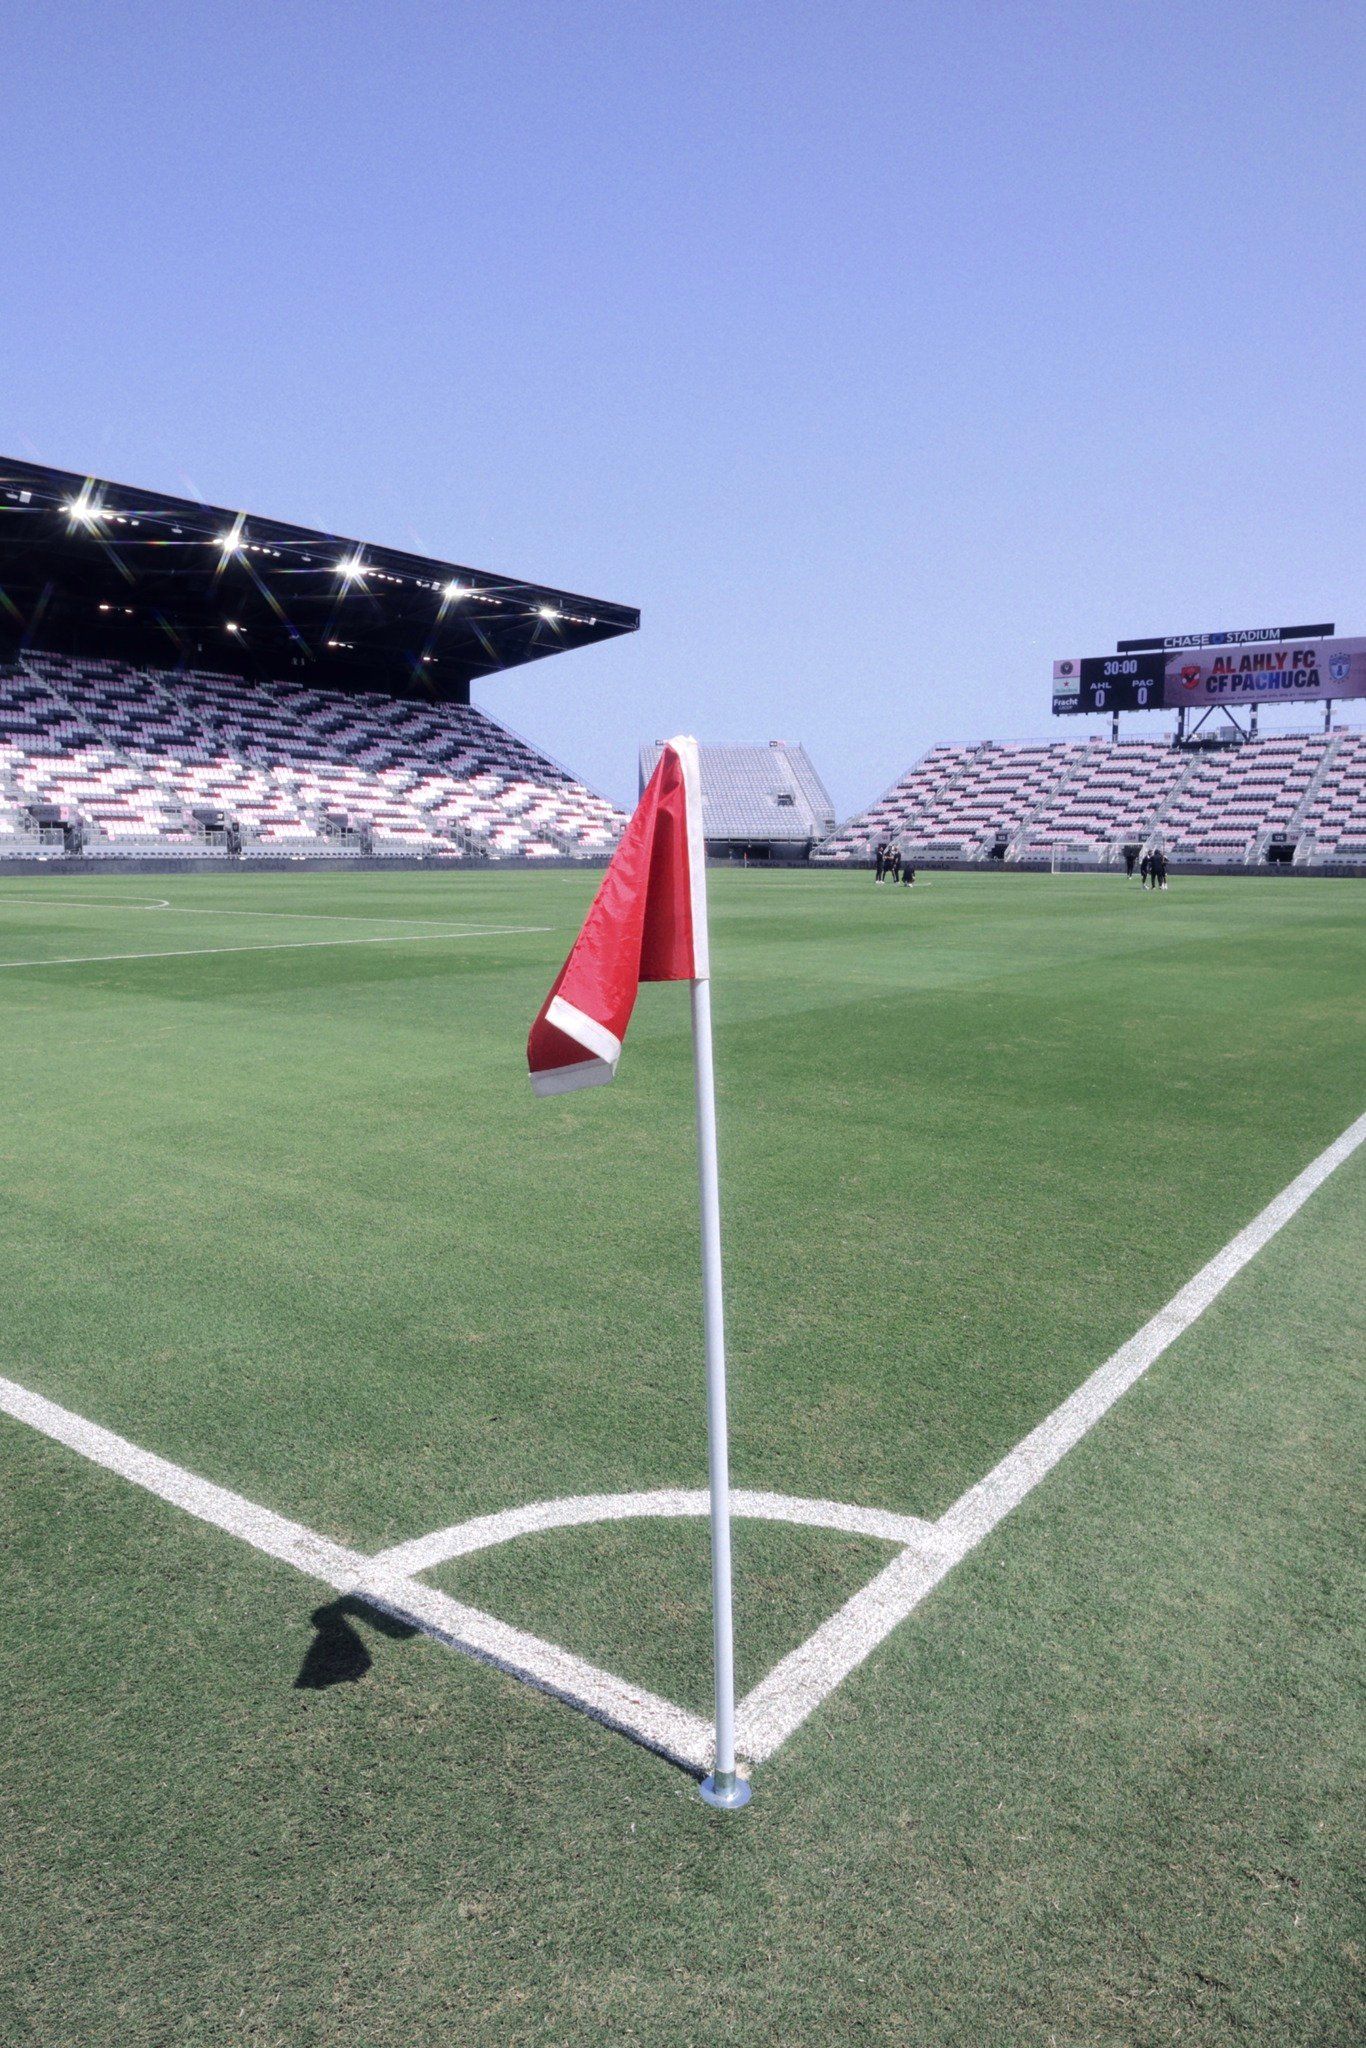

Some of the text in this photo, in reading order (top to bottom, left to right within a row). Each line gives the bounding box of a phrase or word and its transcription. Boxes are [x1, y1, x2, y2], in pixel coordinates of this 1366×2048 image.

[1164, 628, 1280, 647] CHASE STADIUM
[1104, 660, 1138, 675] 30:00
[1212, 650, 1315, 674] AL AHLY FC
[1132, 679, 1154, 687] PAC
[1206, 669, 1320, 693] CF PACHUCA
[1054, 697, 1078, 706] Fracht
[1095, 690, 1105, 707] 0
[1138, 687, 1148, 705] 0
